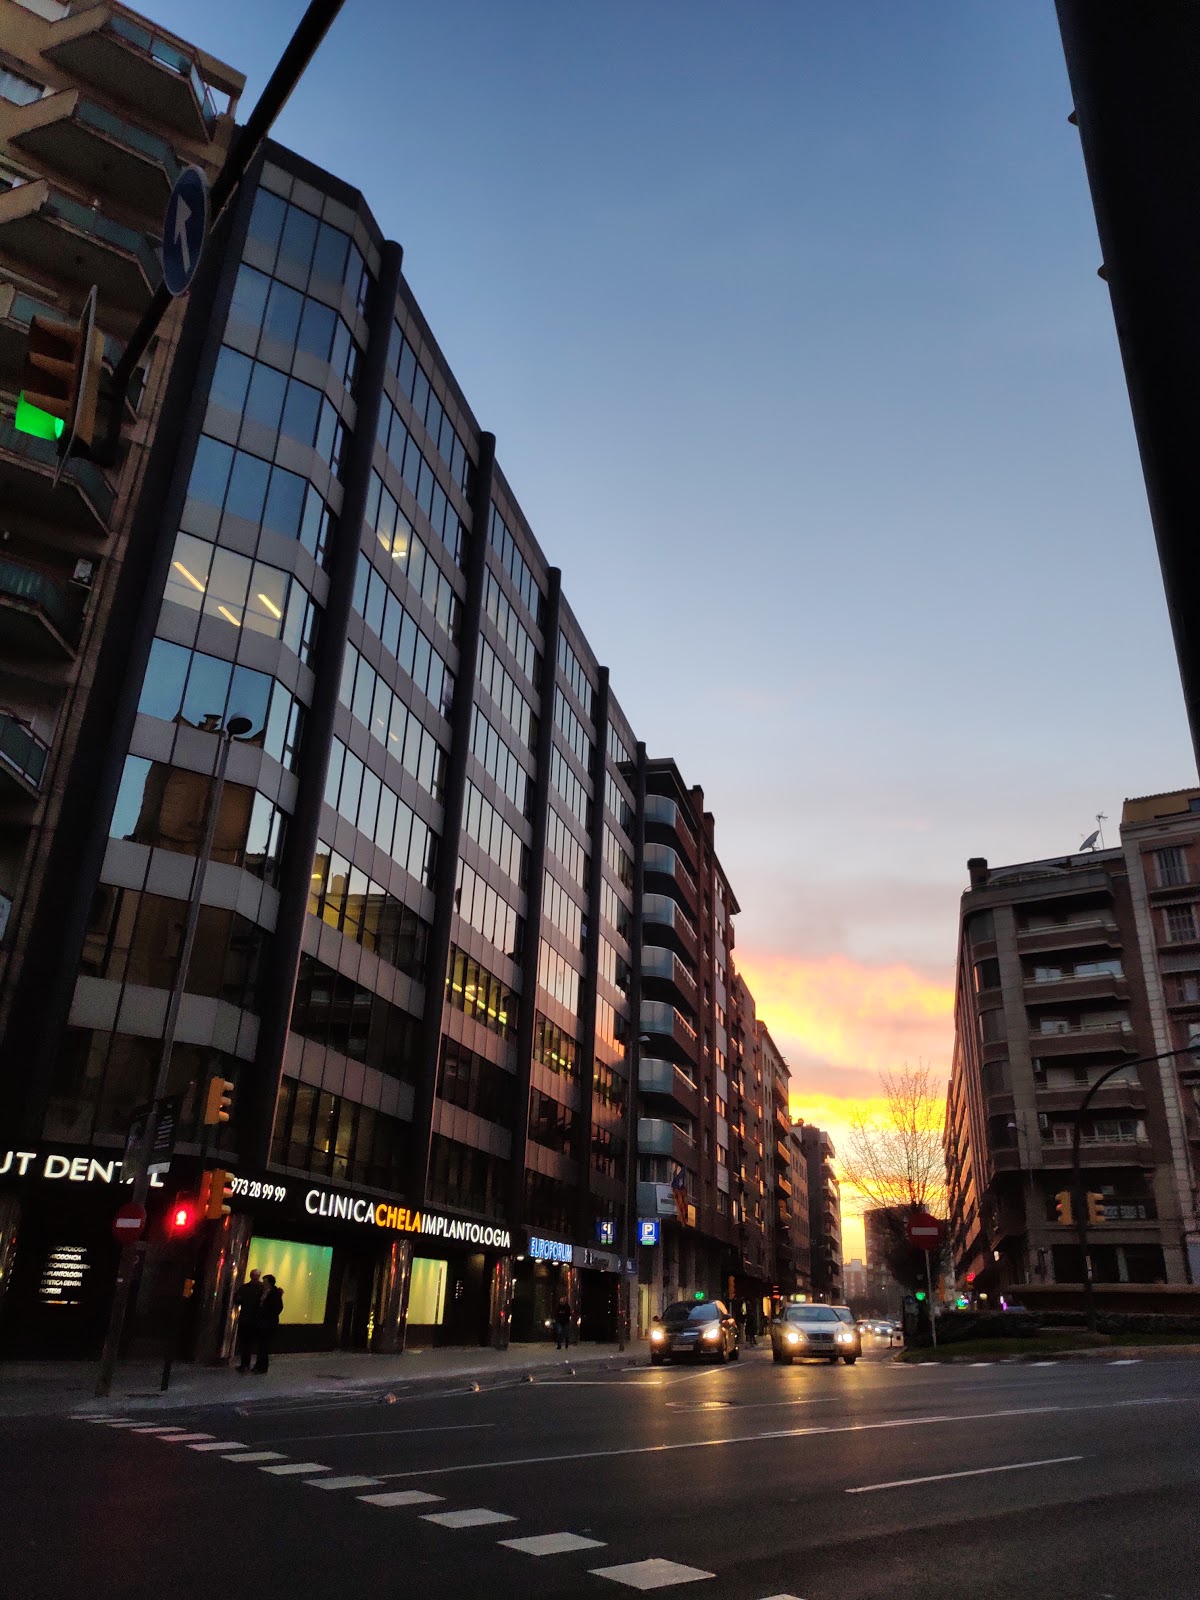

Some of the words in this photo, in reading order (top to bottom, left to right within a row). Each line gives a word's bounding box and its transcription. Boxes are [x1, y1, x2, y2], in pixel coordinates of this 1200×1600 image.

[44, 1155, 164, 1188] DENL
[231, 1177, 248, 1196] 973
[249, 1181, 261, 1198] 28
[262, 1183, 274, 1200] 99
[274, 1186, 286, 1203] 99
[529, 1236, 573, 1263] EUROFORUM
